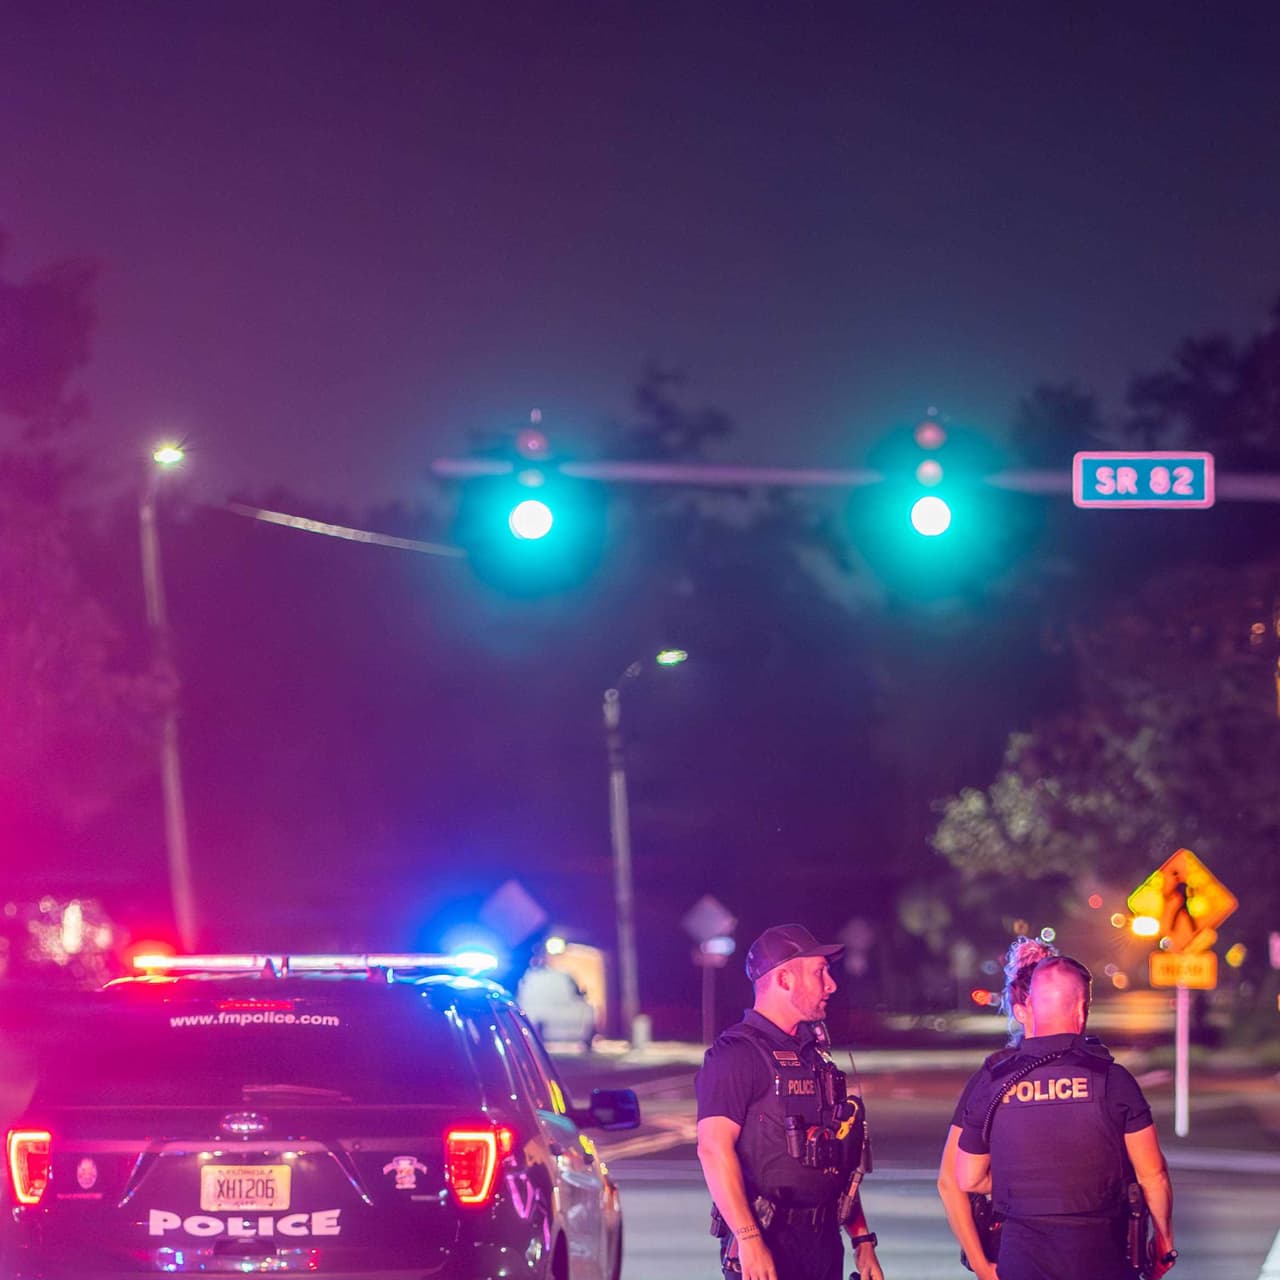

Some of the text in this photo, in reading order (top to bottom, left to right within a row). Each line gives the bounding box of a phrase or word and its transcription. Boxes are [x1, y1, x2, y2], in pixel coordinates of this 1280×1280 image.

[1095, 466, 1138, 495] SR
[170, 1011, 340, 1027] www.fmpolice.com
[788, 1079, 816, 1095] POLICE
[216, 1178, 275, 1199] XH1206
[148, 1208, 342, 1237] POLICE
